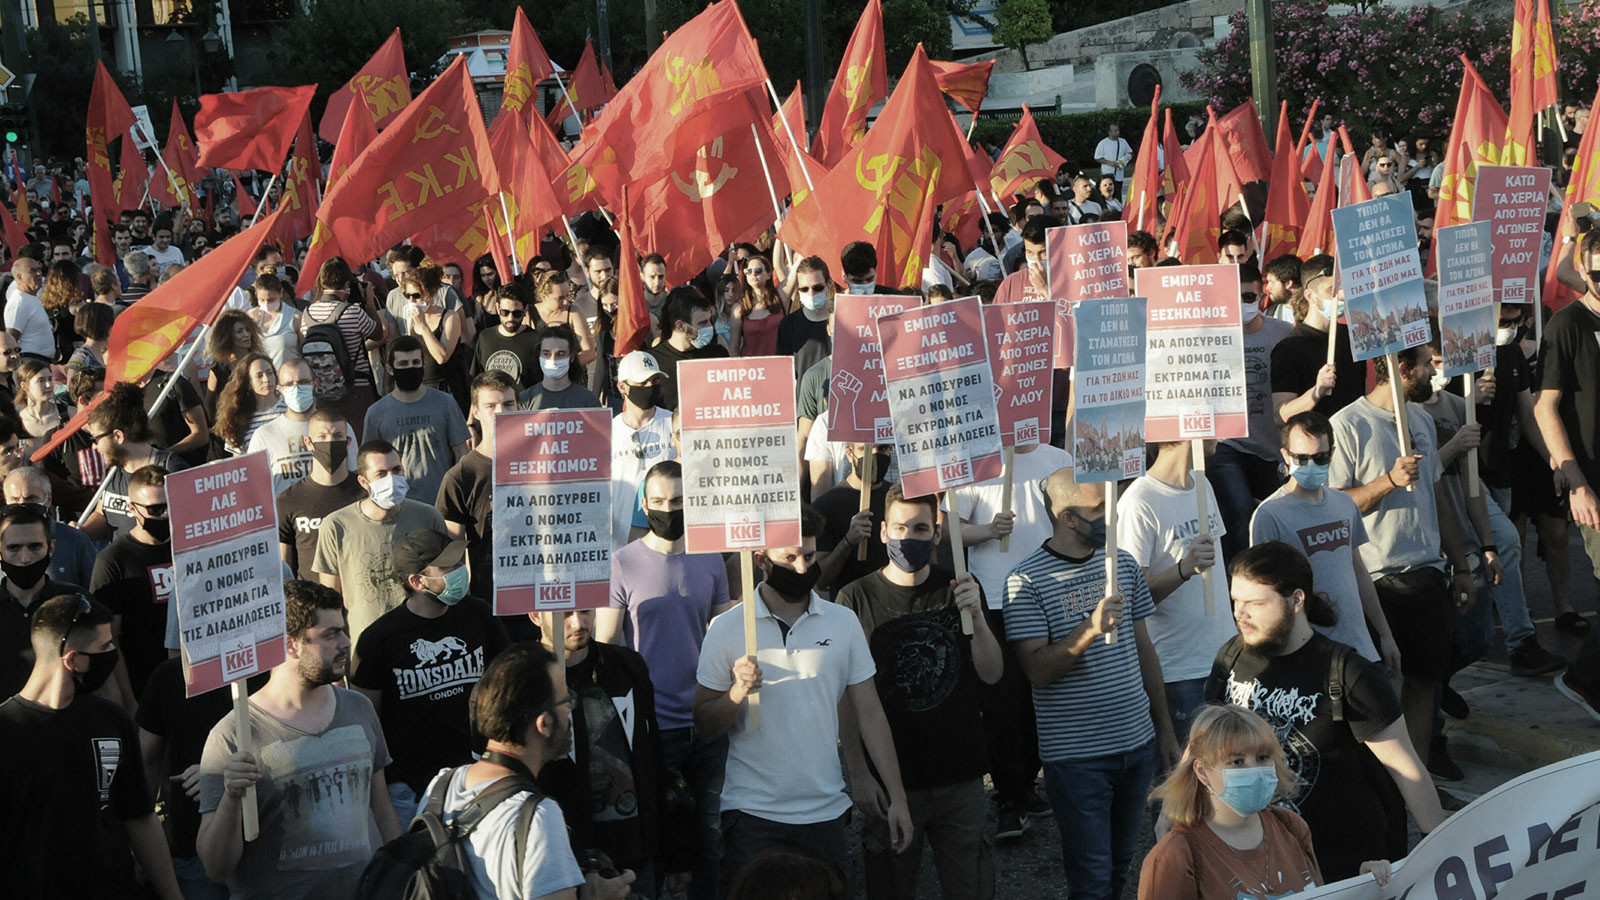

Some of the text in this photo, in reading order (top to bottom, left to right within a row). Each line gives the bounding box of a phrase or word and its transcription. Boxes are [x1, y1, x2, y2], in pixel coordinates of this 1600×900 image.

[1505, 175, 1535, 187] ΚΑΤΩ
[1493, 192, 1544, 204] ΤΑ ΧΕΡΙΑ
[1356, 202, 1389, 217] ΤΙΠΟΤΑ
[1495, 208, 1541, 219] ΑΠΟ ΤΟΥΣ
[1359, 215, 1392, 232] ΔΕΝ ΘΑ
[1496, 223, 1539, 234] ΑΓΩΝΕΣ
[1079, 230, 1110, 246] ΚΑΤΩ
[1348, 226, 1406, 249] ΣΤΑΜΑΤΗΣΕΙ
[1509, 239, 1527, 248] ΤΟΥ
[1069, 246, 1124, 266] ΤΑ ΧΕΡΙΑ
[1353, 240, 1404, 261] ΤΟΝ ΑΓΩΝΑ
[1501, 252, 1532, 264] ΛΑΟΥ
[1074, 262, 1122, 281] ΑΠΟ ΤΟΥΣ
[1352, 254, 1411, 280] ΓΙΑ ΤΗ ΖΩΗ ΜΑΣ
[1080, 278, 1123, 296] ΑΓΩΝΕΣ
[1161, 274, 1214, 288] ΕΜΠΡΟΣ
[1351, 268, 1417, 295] ΓΙΑ ΤΟ ΔΙΚΙΟ ΜΑΣ
[1176, 291, 1202, 303] ΛΑΕ
[1504, 286, 1523, 297] ΚΚΕ
[1008, 309, 1039, 325] ΚΑΤΩ
[1101, 303, 1128, 315] ΤΙΠΟΤΑ
[1150, 307, 1227, 321] ΞΕΣΗΚΩΜΟΣ
[904, 311, 957, 333] ΕΜΠΡΟΣ
[1101, 319, 1129, 332] ΔΕΝ ΘΑ
[856, 325, 872, 337] ΤΑ
[921, 331, 947, 347] ΛΑΕ
[995, 325, 1051, 345] ΤΑ ΧΕΡΙΑ
[1405, 329, 1425, 344] ΚΚΕ
[1089, 335, 1138, 349] ΣΤΑΜΑΤΗΣΕΙ
[1150, 335, 1232, 349] ΝΑ ΑΠΟΣΥΡΘΕΙ
[897, 343, 974, 370] ΞΕΣΗΚΩΜΟΣ
[999, 343, 1048, 360] ΑΠΟ ΤΟΥΣ
[1092, 351, 1136, 366] ΤΟΝ ΑΓΩΝΑ
[1168, 353, 1217, 364] Ο ΝΟΜΟΣ
[707, 368, 765, 382] ΕΜΠΡΟΣ
[1003, 359, 1047, 376] ΑΓΩΝΕΣ
[1017, 376, 1036, 389] ΤΟΥ
[1087, 370, 1140, 386] ΓΙΑ ΤΗ ΖΩΗ ΜΑΣ
[1155, 370, 1231, 383] ΕΚΤΡΩΜΑ ΓΙΑ
[723, 387, 752, 400] ΛΑΕ
[899, 374, 981, 401] ΝΑ ΑΠΟΣΥΡΘΕΙ
[1083, 387, 1143, 404] ΓΙΑ ΤΟ ΔΙΚΙΟ ΜΑΣ
[1145, 386, 1242, 400] ΤΙΣ ΔΙΑΔΗΛΩΣΕΙΣ
[919, 395, 968, 414] Ο ΝΟΜΟΣ
[1010, 390, 1043, 408] ΛΑΟΥ
[695, 403, 781, 420] ΞΕΣΗΚΩΜΟΣ
[396, 415, 431, 427] ELEMENT
[525, 421, 583, 436] ΕΜΠΡΟΣ
[908, 410, 983, 435] ΕΚΤΡΩΜΑ ΓΙΑ
[1184, 417, 1211, 430] ΚΚΕ
[877, 428, 894, 438] ΚΚ
[901, 425, 996, 454] ΤΙΣ ΔΙΑΔΗΛΩΣΕΙΣ
[1017, 427, 1037, 443] ΚΚΕ
[539, 441, 569, 455] ΛΑΕ
[694, 435, 785, 450] ΝΑ ΑΠΟΣΥΡΘΕΙ
[281, 459, 313, 480] DIST
[510, 458, 597, 475] ΞΕΣΗΚΩΜΟΣ
[713, 455, 768, 468] Ο ΝΟΜΟΣ
[1125, 460, 1140, 473] ΚΚΕ
[942, 462, 969, 480] ΚΚΕ
[195, 467, 247, 494] ΕΜΠΡΟΣ
[700, 473, 784, 487] ΕΚΤΡΩΜΑ ΓΙΑ
[211, 491, 237, 511] ΛΑΕ
[507, 492, 600, 507] ΝΑ ΑΠΟΣΥΡΘΕΙ
[688, 490, 796, 506] ΤΙΣ ΔΙΑΔΗΛΩΣΕΙΣ
[185, 506, 263, 539] ΞΕΣΗΚΩΜΟΣ
[526, 513, 582, 526] Ο ΝΟΜΟΣ
[511, 531, 596, 547] ΕΚΤΡΩΜΑ ΓΙΑ
[730, 524, 761, 539] ΚΚΕ
[186, 541, 268, 576] ΝΑ ΑΠΟΣΥΡΘΕΙ
[499, 550, 608, 567] ΤΙΣ ΔΙΑΔΗΛΩΣΕΙΣ
[205, 567, 254, 592] Ο ΝΟΜΟΣ
[540, 585, 571, 600] ΚΚΕ
[194, 584, 269, 618] ΕΚΤΡΩΜΑ ΓΙΑ
[184, 601, 281, 642] ΤΙΣ ΔΙΑΔΗΛΩΣΕΙΣ
[226, 648, 253, 671] ΚΚΕ
[429, 686, 464, 701] LONDON
